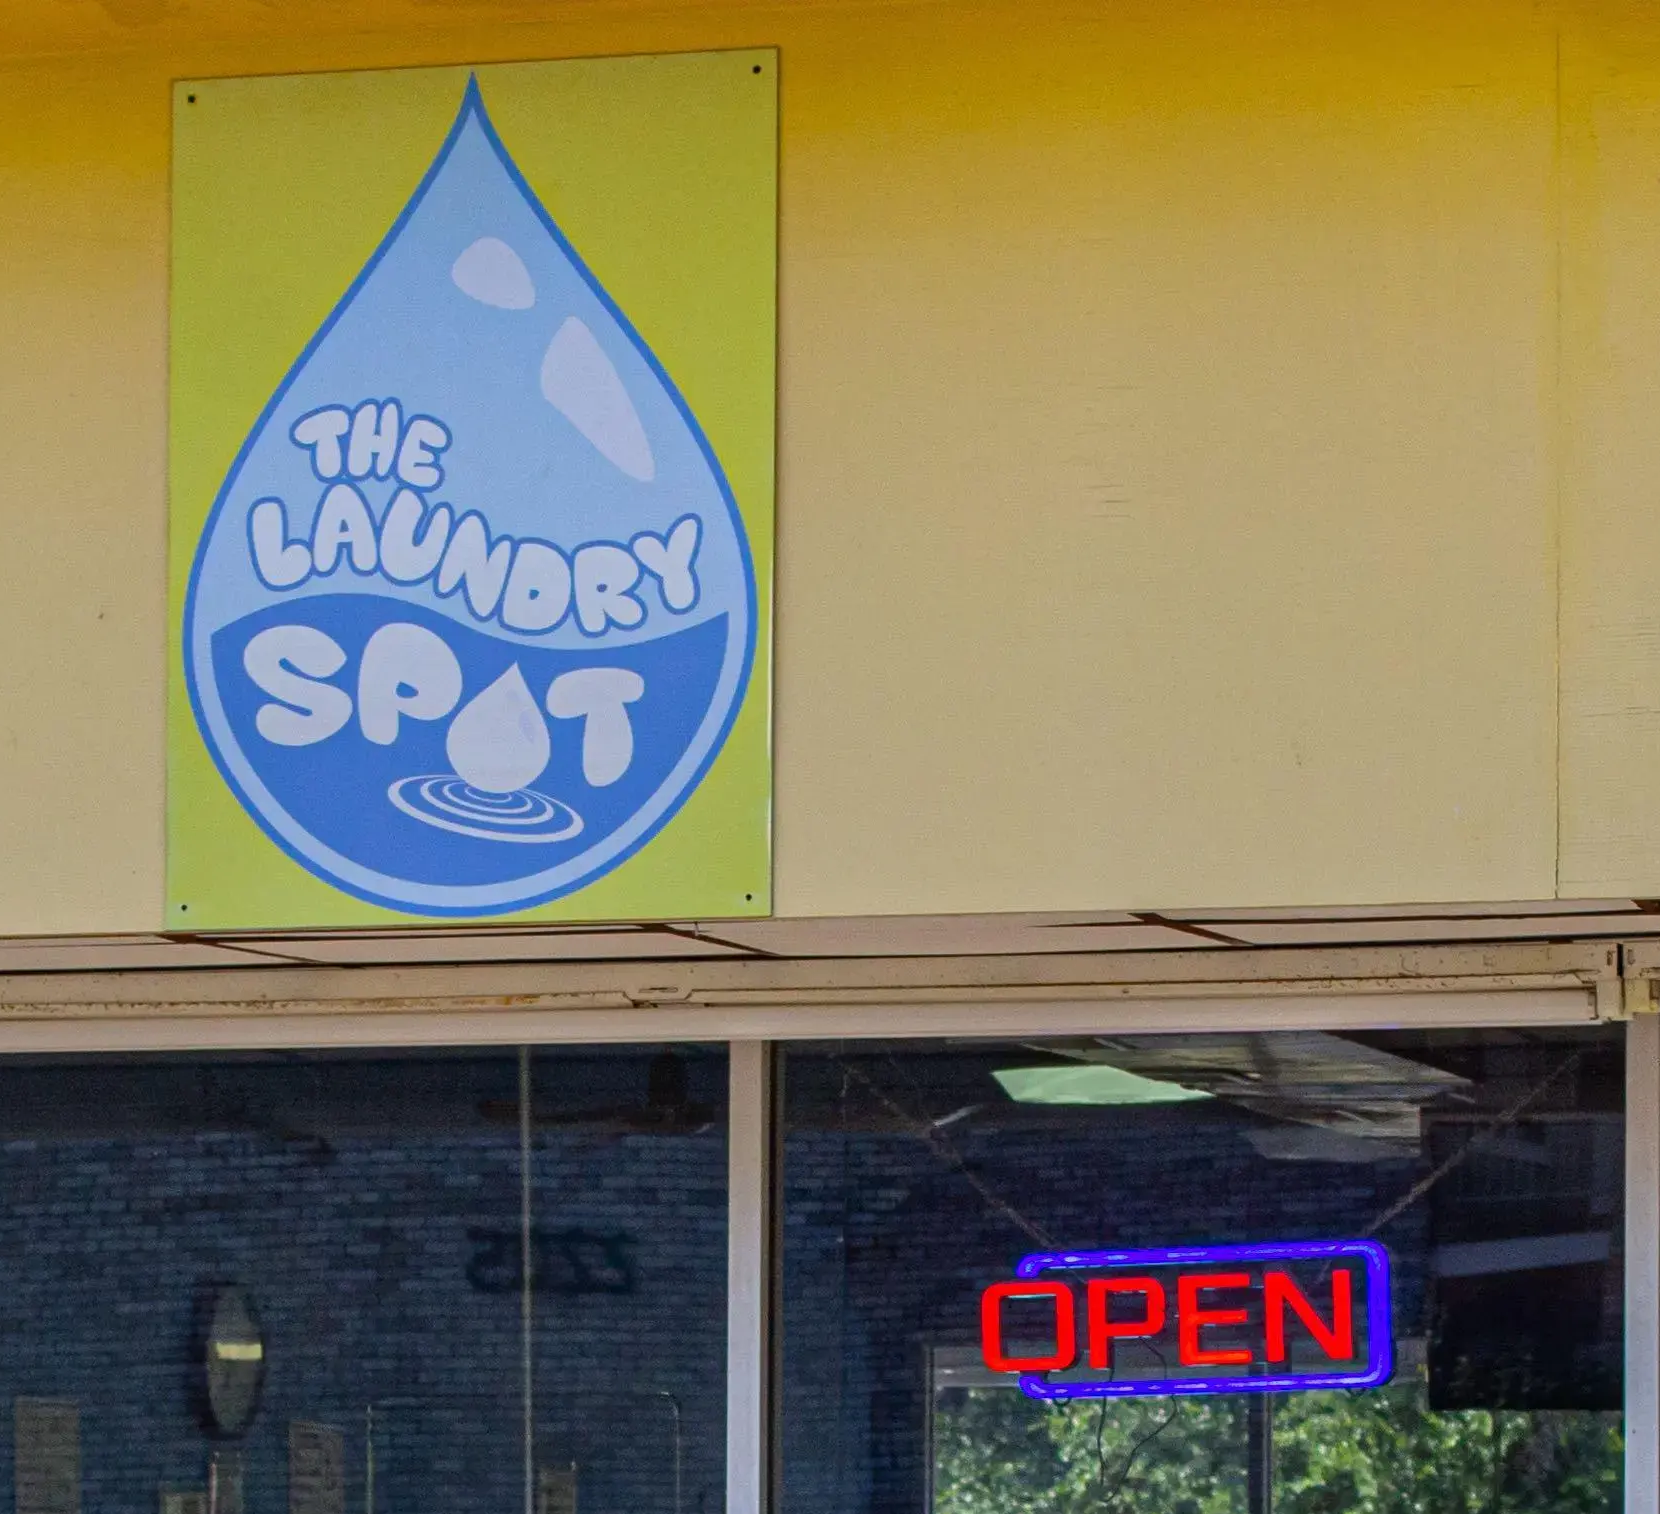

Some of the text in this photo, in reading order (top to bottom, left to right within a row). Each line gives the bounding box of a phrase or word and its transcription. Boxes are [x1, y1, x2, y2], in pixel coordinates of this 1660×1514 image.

[288, 397, 451, 490] THE
[246, 482, 703, 637] LAUNDRY
[242, 622, 646, 795] SPOT
[981, 1267, 1354, 1374] OPEN
